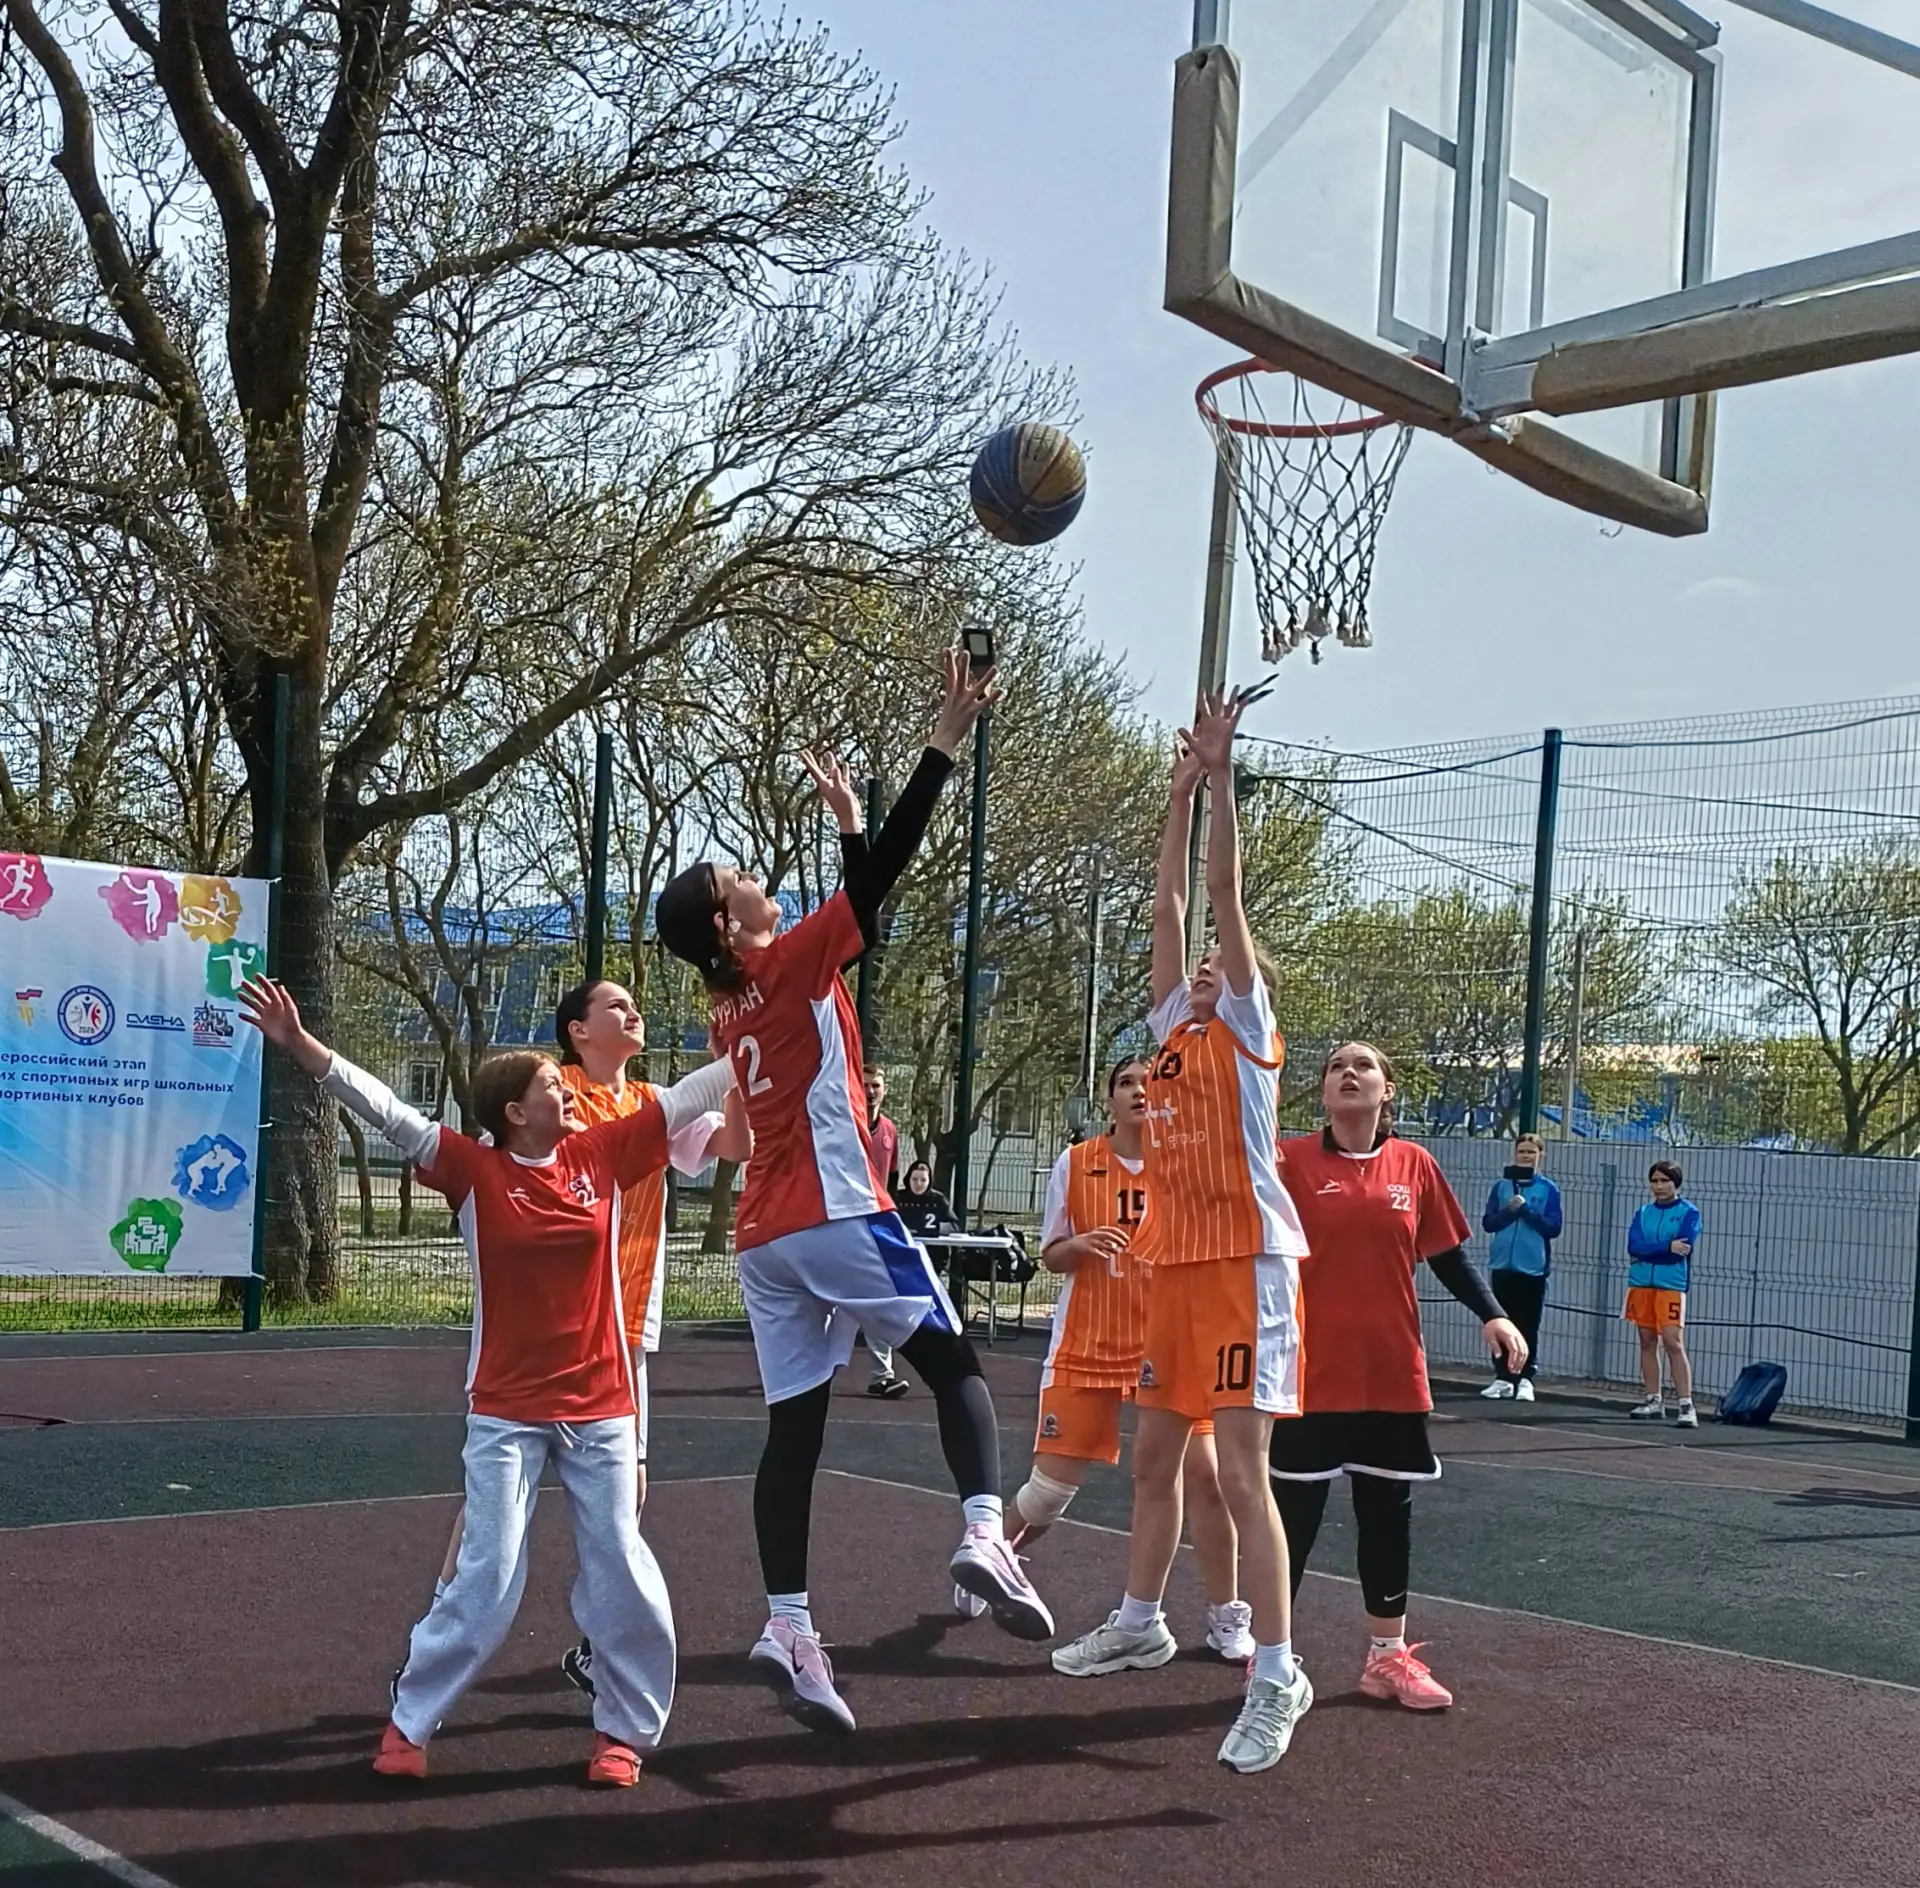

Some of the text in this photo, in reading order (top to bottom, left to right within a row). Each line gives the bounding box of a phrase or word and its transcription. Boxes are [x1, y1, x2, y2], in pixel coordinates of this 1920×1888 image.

[1, 1053, 146, 1070] ероссийский этап
[737, 1034, 773, 1096] 2
[22, 1072, 119, 1087] спортивных
[124, 1078, 149, 1091] игр
[155, 1080, 234, 1092] школьных
[89, 1093, 144, 1107] клубов
[1167, 1130, 1206, 1149] group
[1390, 1193, 1412, 1212] 22
[925, 1213, 937, 1229] 2
[1668, 1302, 1681, 1321] 5
[1213, 1343, 1253, 1393] 10
